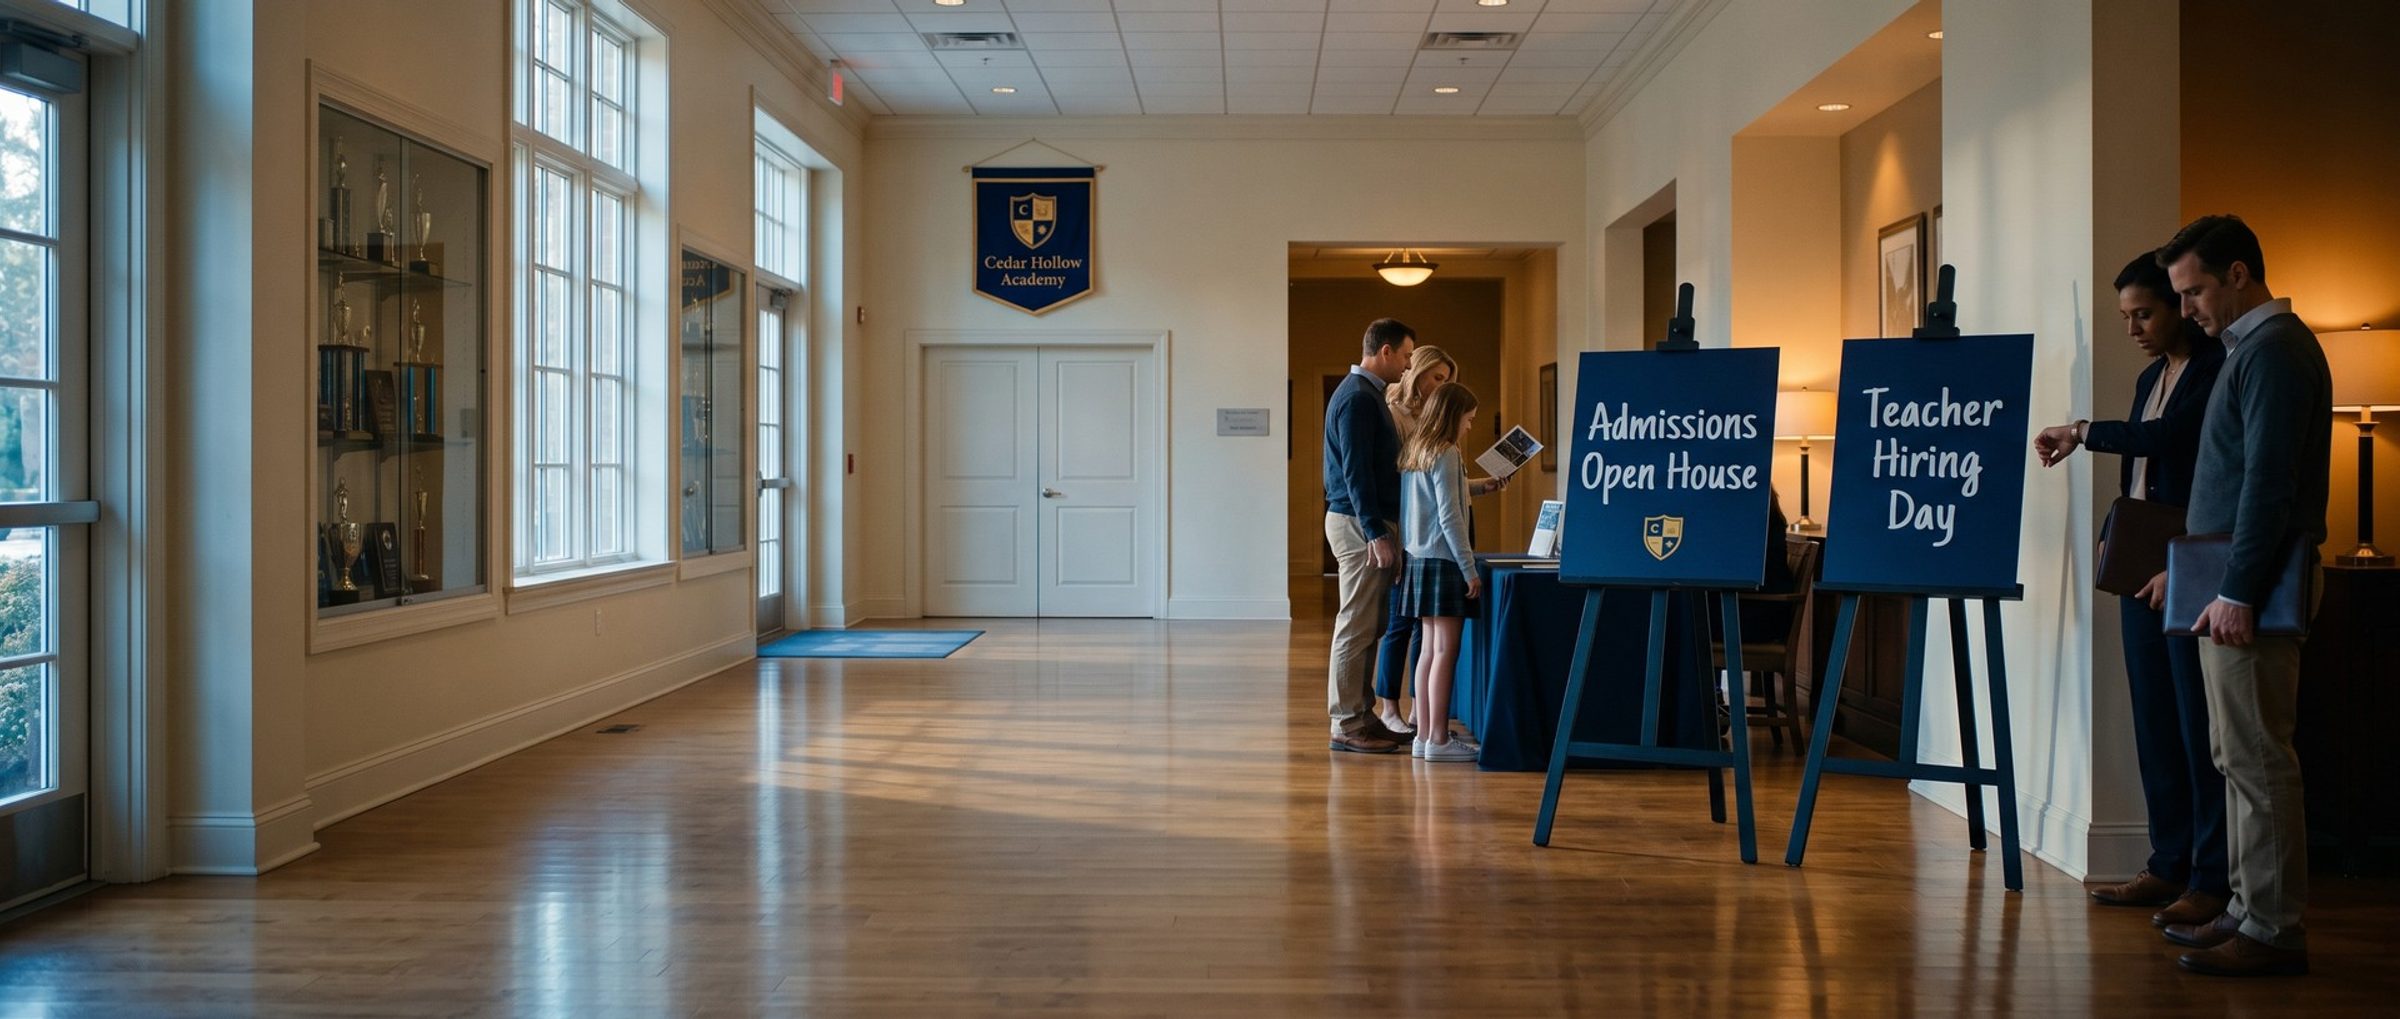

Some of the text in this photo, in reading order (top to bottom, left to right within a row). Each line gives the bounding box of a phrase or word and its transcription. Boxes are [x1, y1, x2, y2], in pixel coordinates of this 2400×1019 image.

[984, 256, 1082, 269] Cedar Hollow
[1001, 273, 1066, 289] Academy
[1588, 402, 1758, 441] Admissions
[1863, 387, 2003, 428] Teacher
[1581, 451, 1758, 505] Open House
[1873, 437, 1983, 498] Hiring
[1650, 523, 1660, 534] C
[1888, 490, 1956, 547] Day
